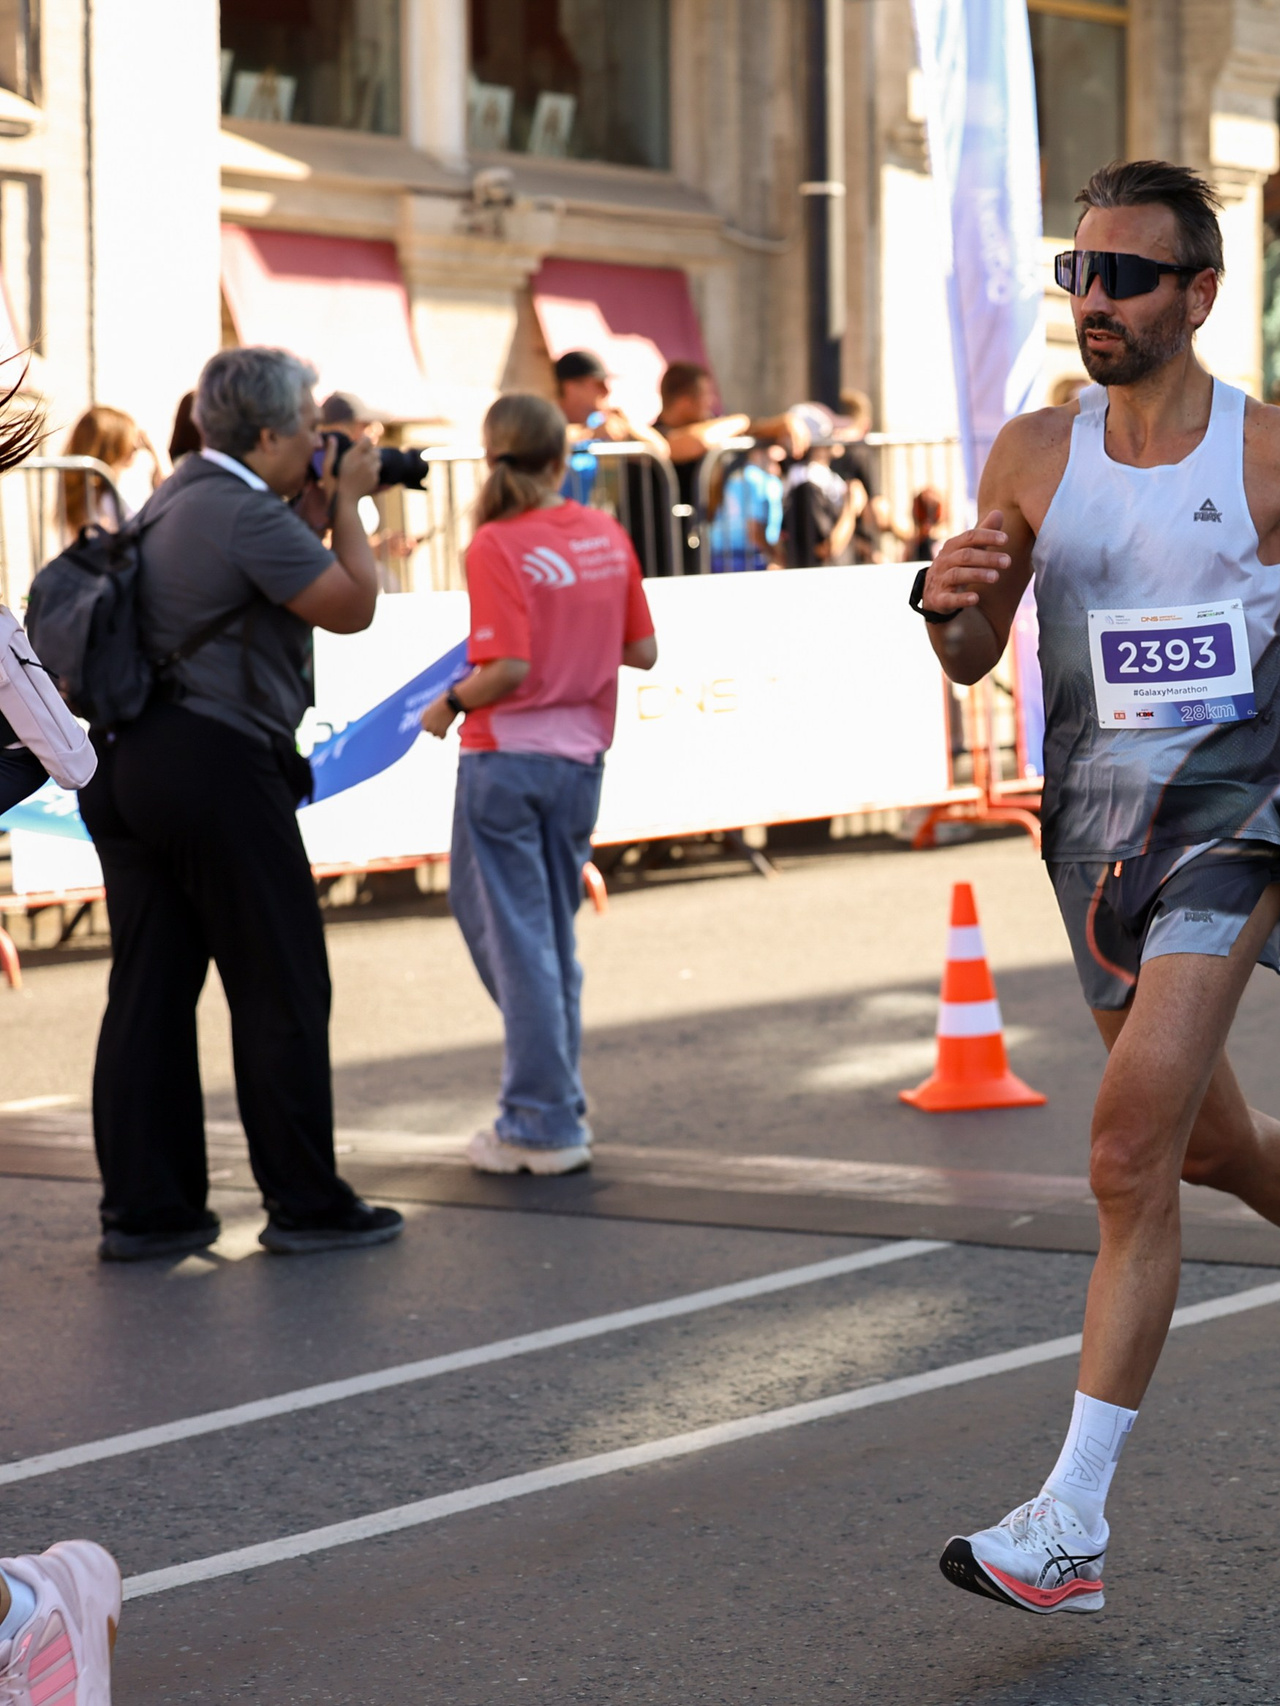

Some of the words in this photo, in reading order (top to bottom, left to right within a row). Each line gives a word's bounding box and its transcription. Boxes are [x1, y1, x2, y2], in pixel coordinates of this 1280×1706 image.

[1117, 635, 1217, 674] 2393
[1133, 685, 1208, 697] #GalaxyMarathon
[1180, 703, 1236, 722] 28km
